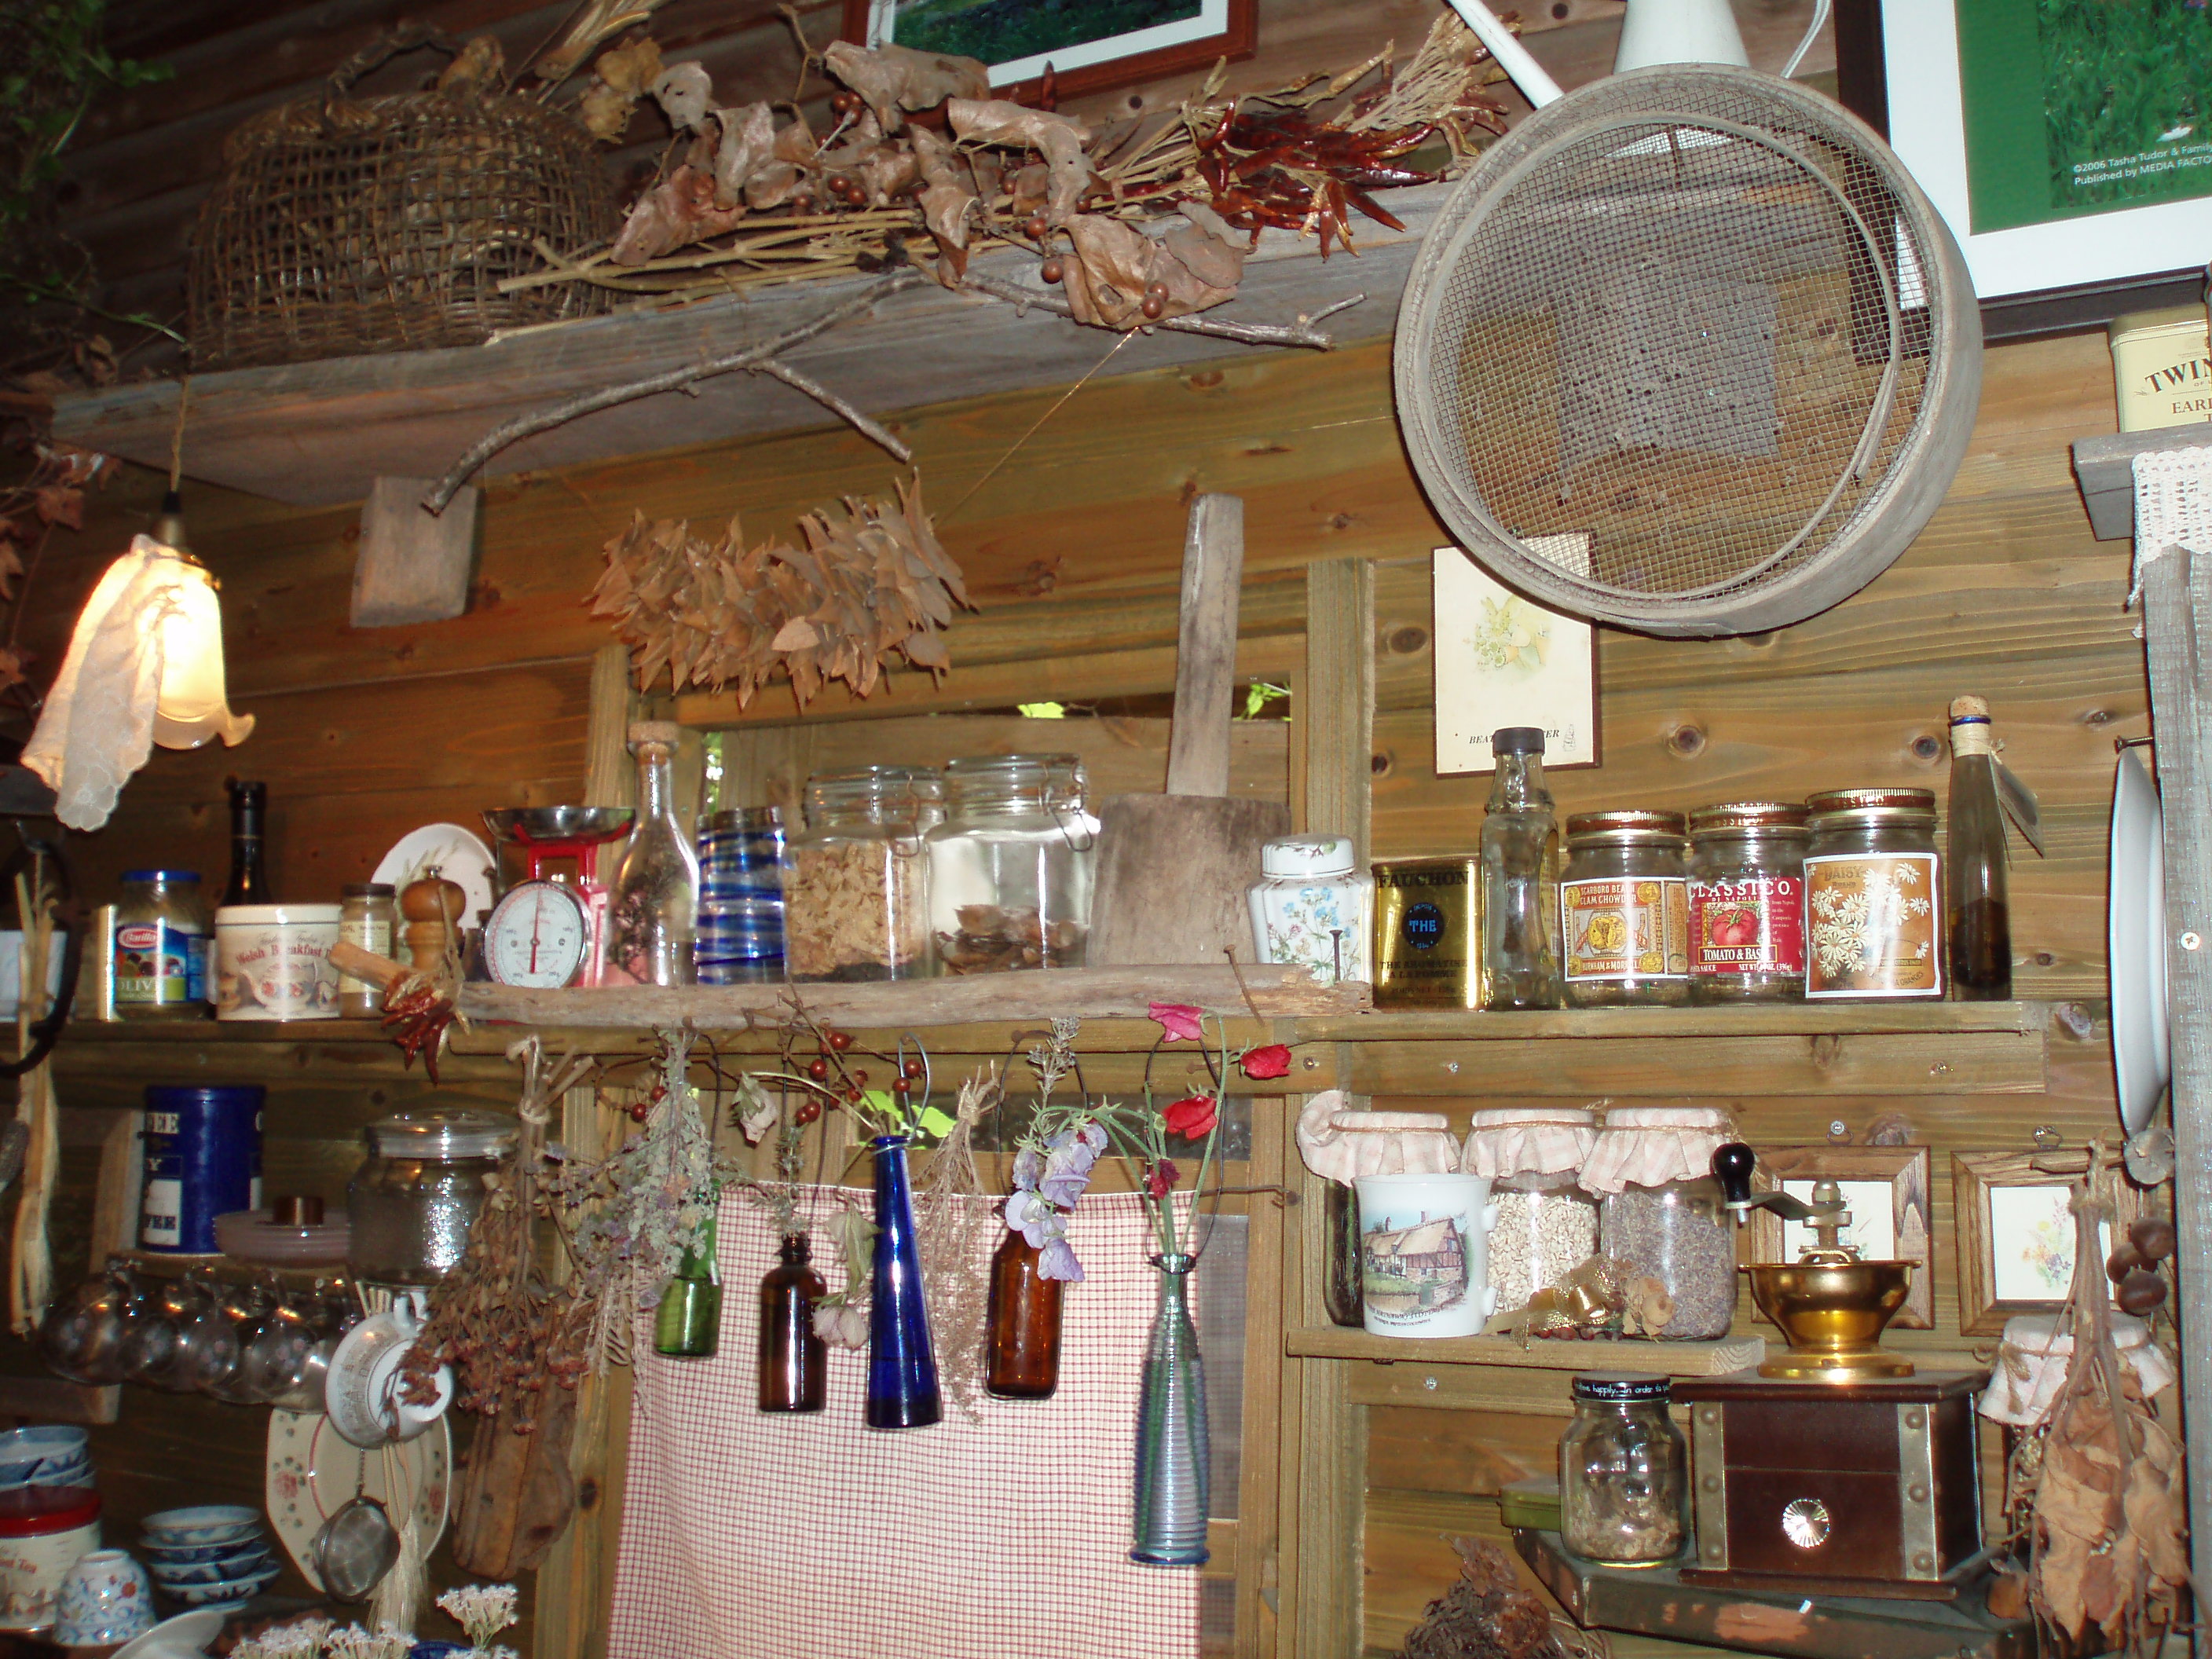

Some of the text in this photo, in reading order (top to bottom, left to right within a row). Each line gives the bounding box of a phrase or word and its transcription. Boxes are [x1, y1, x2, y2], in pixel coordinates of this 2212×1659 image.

[2073, 160, 2106, 173] ©2006
[2108, 156, 2136, 167] Tasha
[2138, 150, 2168, 162] Tudor
[2170, 147, 2179, 156] &
[2075, 169, 2122, 185] Published
[2125, 167, 2137, 178] by
[2140, 160, 2175, 174] MEDIA
[1378, 871, 1470, 888] FAUCHON
[1824, 865, 1863, 881] DAISY
[1612, 884, 1636, 893] BEAH
[1580, 895, 1638, 906] CLAM CHOWDR
[1408, 919, 1437, 932] THE
[236, 947, 265, 965] Welsh
[1703, 948, 1735, 961] TOMATO
[1737, 950, 1744, 960] &
